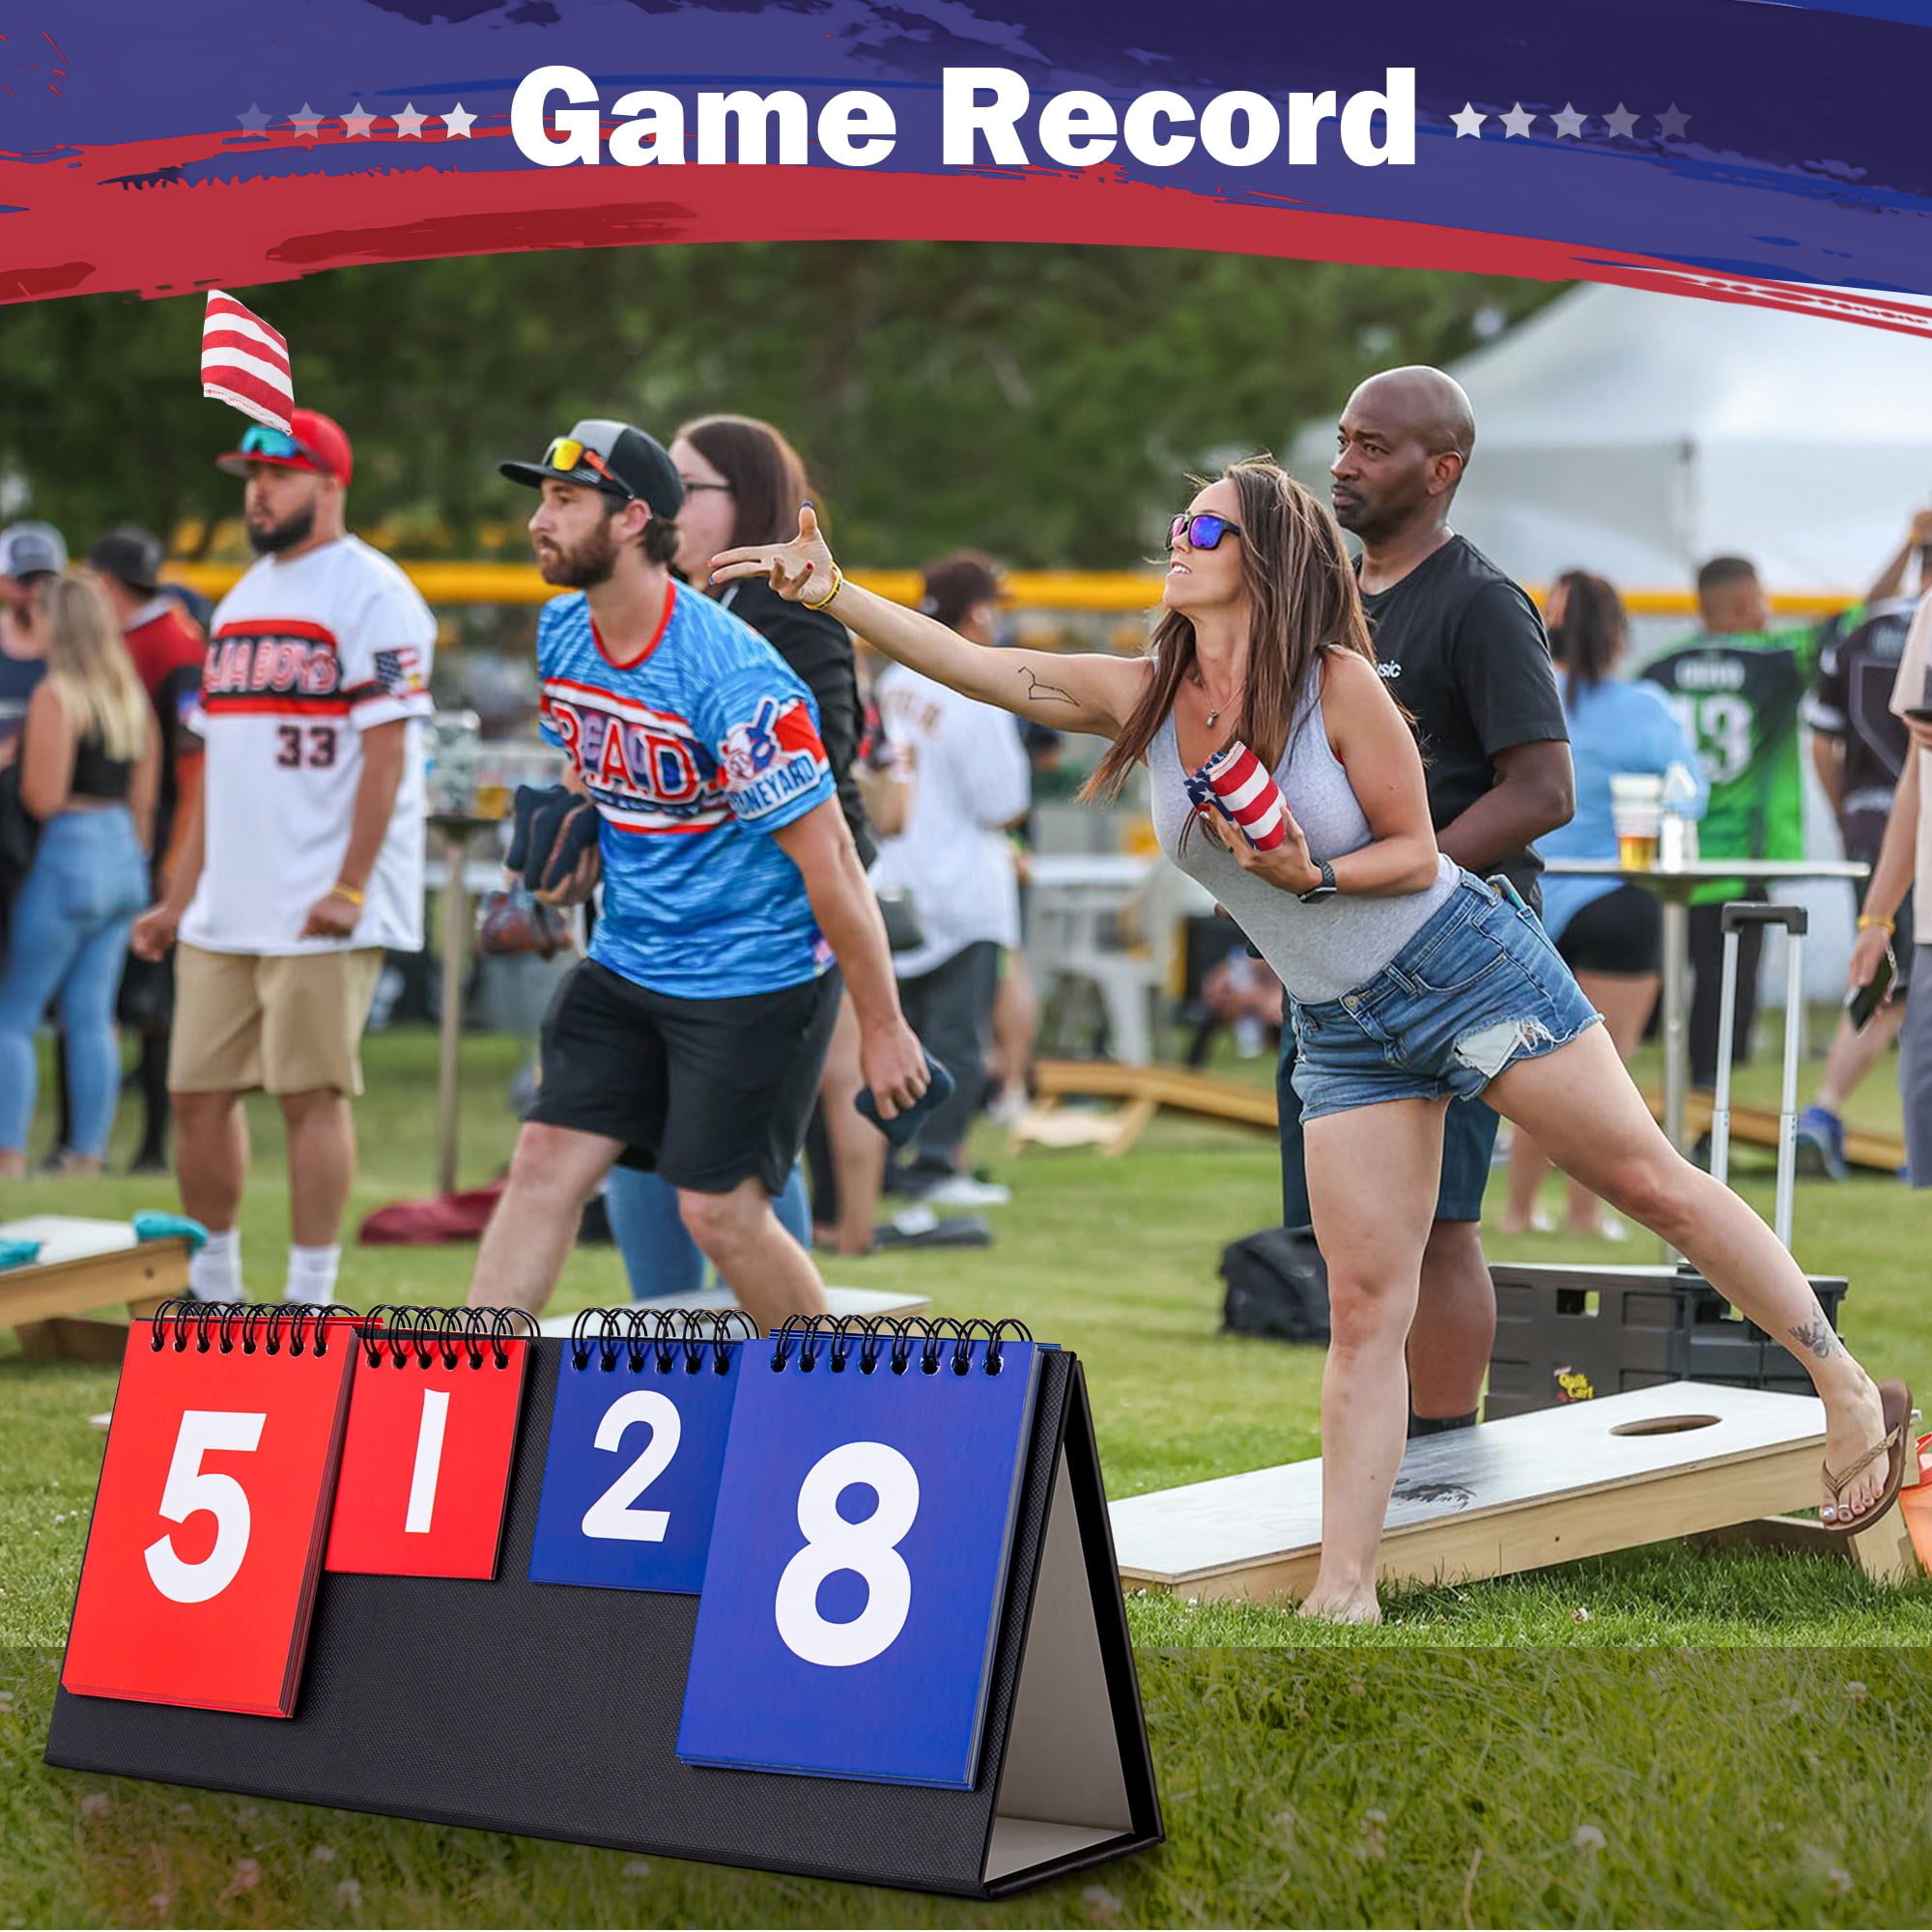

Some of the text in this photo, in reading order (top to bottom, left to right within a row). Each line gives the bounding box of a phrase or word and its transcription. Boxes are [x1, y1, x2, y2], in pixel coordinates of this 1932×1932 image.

[277, 724, 336, 767] 33
[144, 1410, 267, 1604] 5
[405, 1388, 450, 1533] 1
[582, 1390, 681, 1542] 2
[775, 1441, 921, 1666] 8
